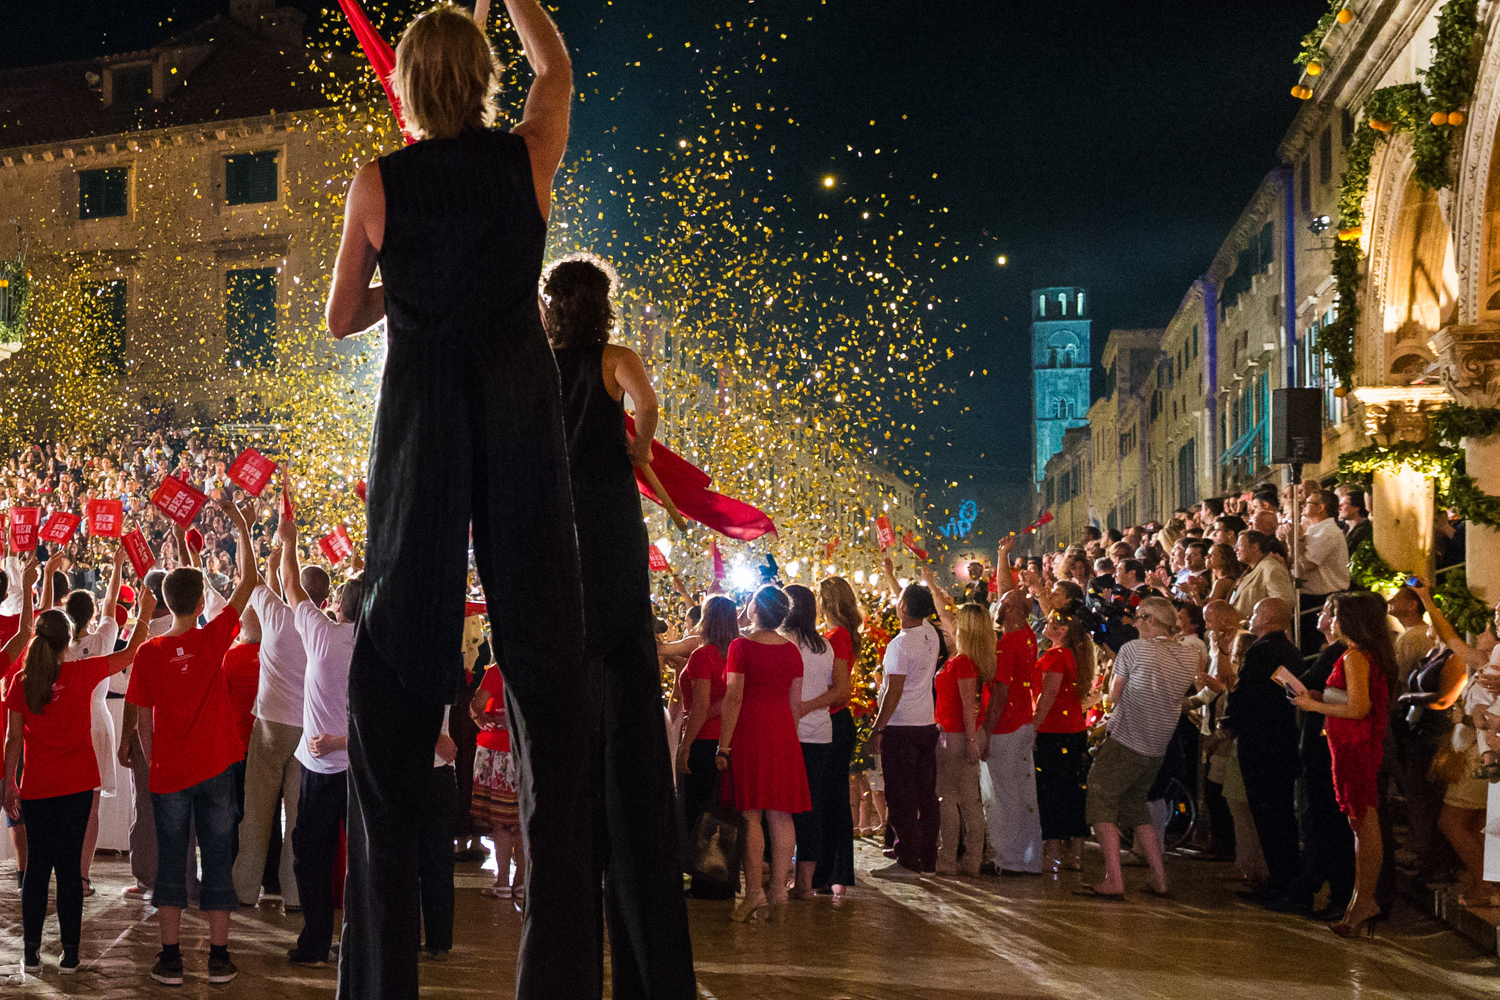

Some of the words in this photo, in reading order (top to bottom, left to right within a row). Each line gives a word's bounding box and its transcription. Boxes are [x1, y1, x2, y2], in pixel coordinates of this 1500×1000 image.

[158, 494, 173, 509] LI
[167, 490, 189, 514] BER
[176, 499, 196, 519] TAS
[15, 514, 26, 524] LI
[15, 524, 32, 534] BER
[52, 523, 71, 533] BER
[15, 534, 30, 545] TAS
